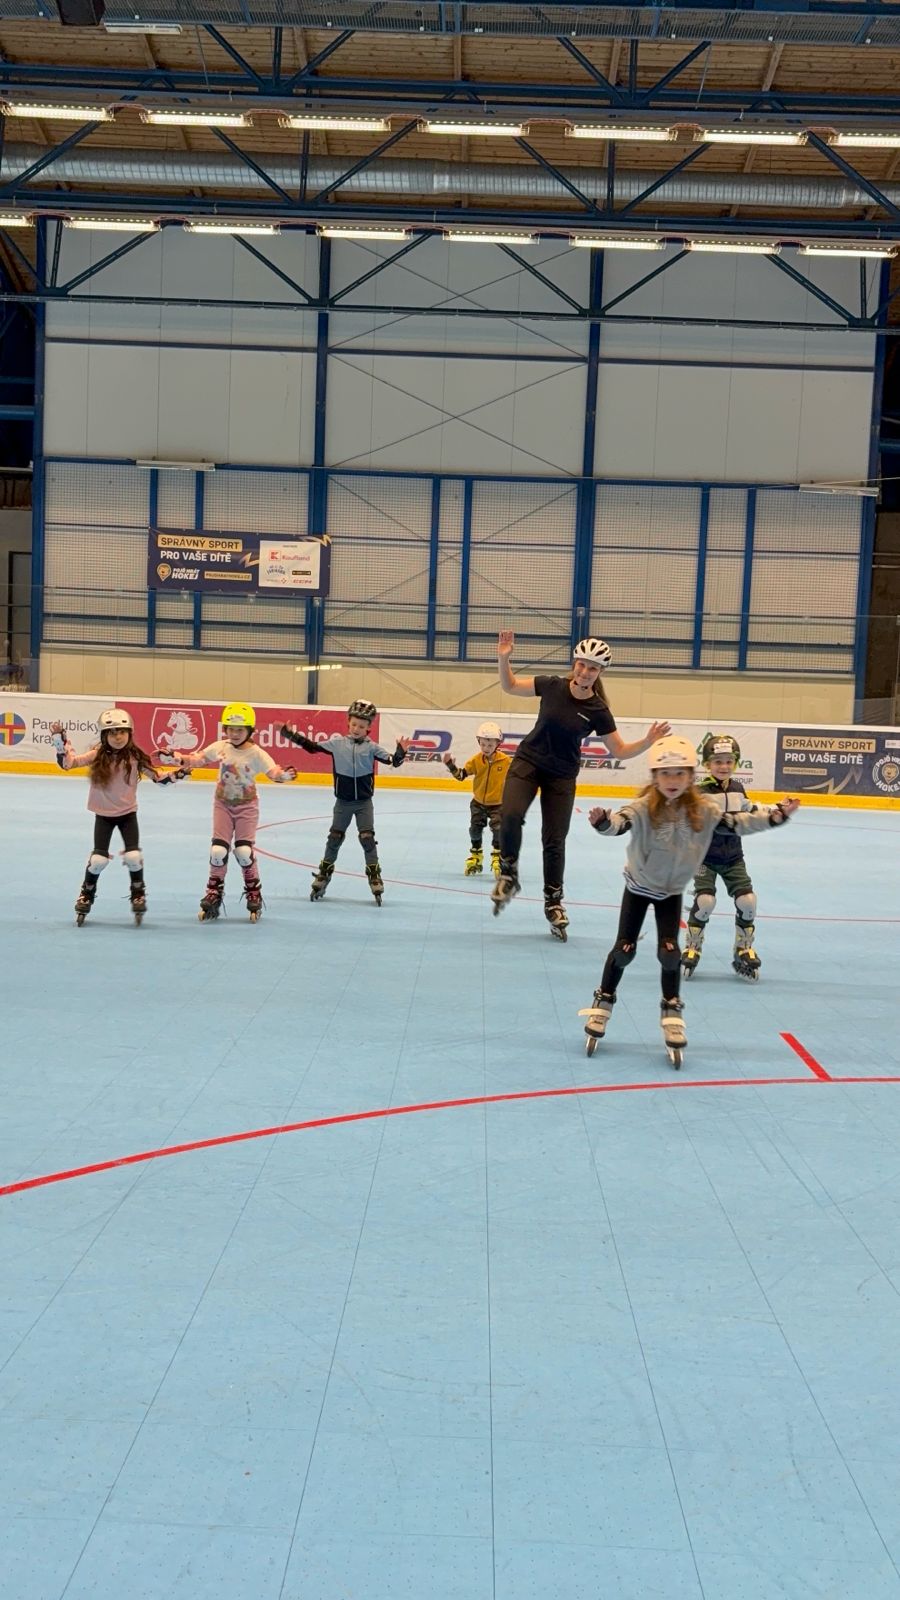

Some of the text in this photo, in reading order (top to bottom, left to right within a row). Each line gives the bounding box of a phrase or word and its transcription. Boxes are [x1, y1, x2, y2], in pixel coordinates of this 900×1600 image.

[161, 537, 239, 549] SPRÁVNÝ SPORT
[160, 551, 231, 563] PRO VAŠE DÍTĚ
[172, 571, 199, 580] HOKEJ
[785, 738, 835, 749] SPRÁVNÝ
[838, 740, 873, 751] SPORT
[784, 752, 864, 765] PRO VAŠE DÍTĚ
[875, 780, 900, 793] HOKE
